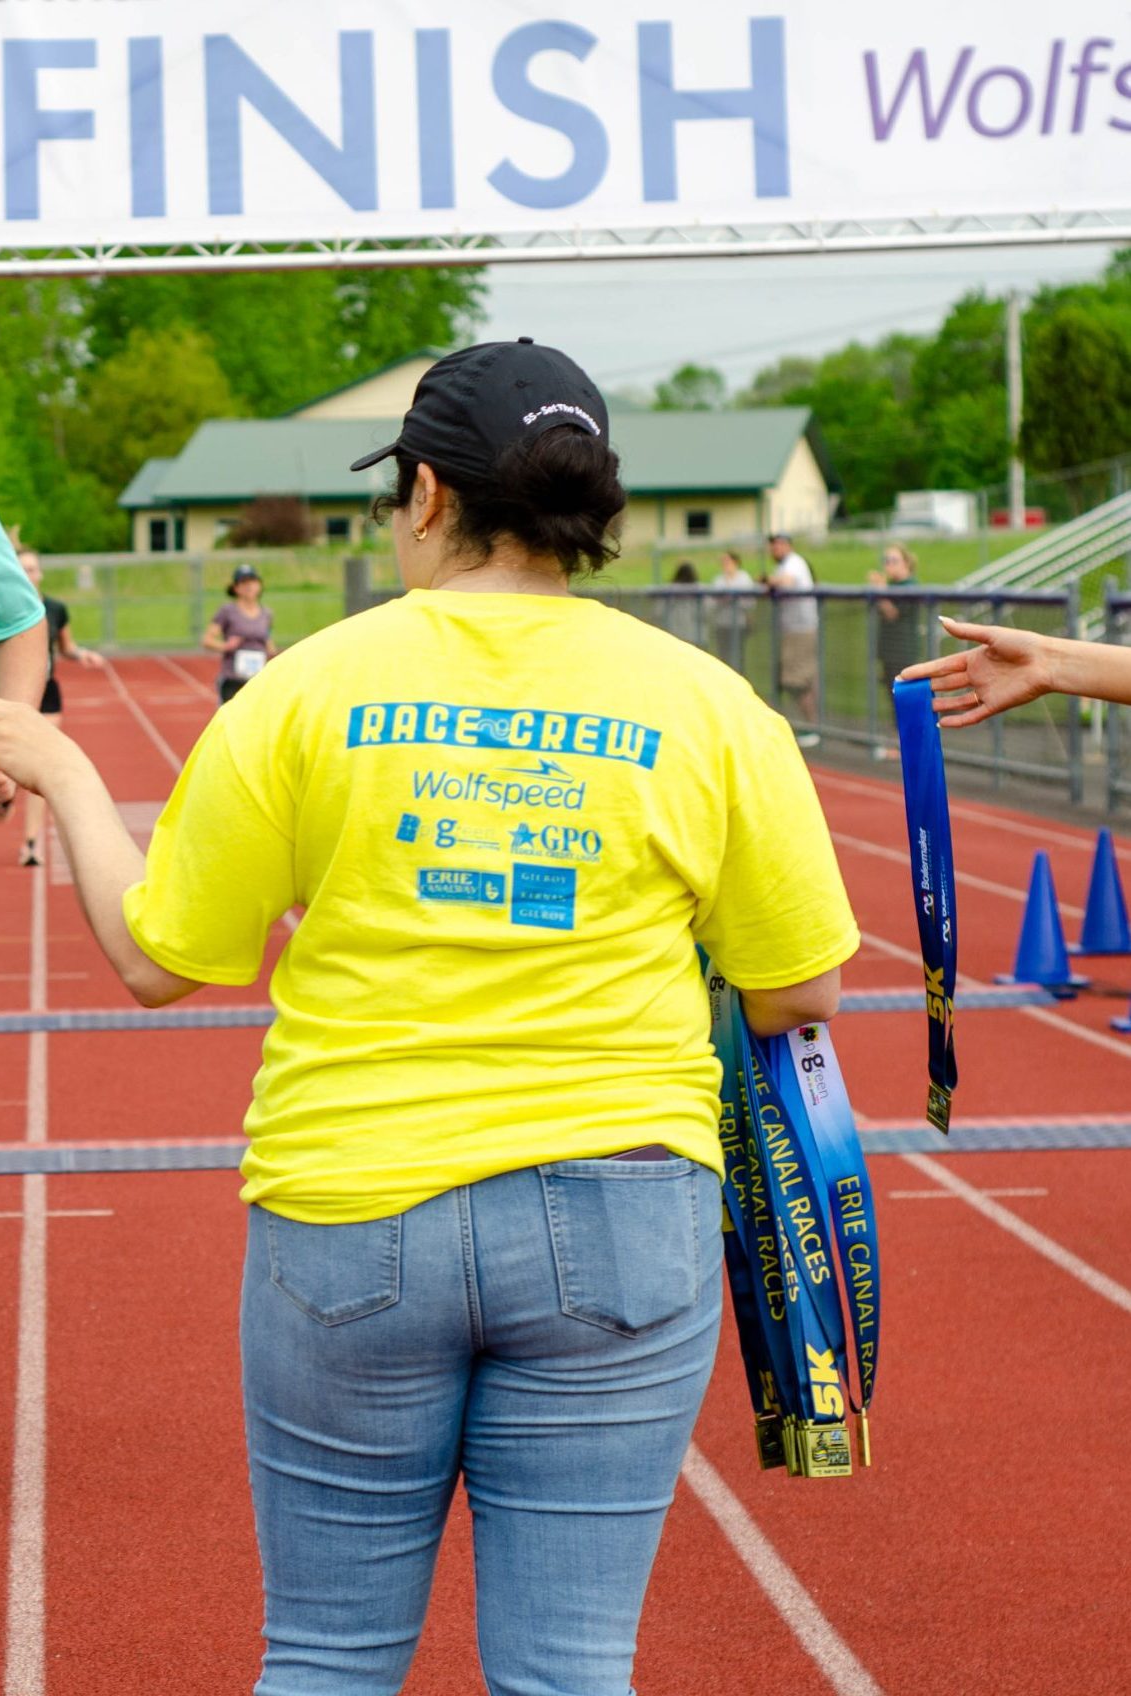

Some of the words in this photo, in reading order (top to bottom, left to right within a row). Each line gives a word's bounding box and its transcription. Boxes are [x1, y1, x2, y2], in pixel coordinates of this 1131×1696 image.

[3, 16, 791, 220] FINISH
[360, 704, 482, 745] RACE
[508, 710, 646, 762] CREW
[413, 771, 586, 810] Wolfspeed
[540, 825, 602, 856] GPO
[919, 826, 930, 890] Boilermaker
[426, 871, 474, 884] ERIE
[521, 873, 566, 884] GILROY
[519, 909, 567, 922] GILROY
[924, 962, 945, 1025] 5K
[747, 1138, 769, 1228] CANAL
[759, 1104, 803, 1196] CANAL
[787, 1196, 830, 1284] RACES
[837, 1174, 867, 1236] ERIE
[848, 1243, 874, 1336] CANAL
[806, 1343, 844, 1418] 5K
